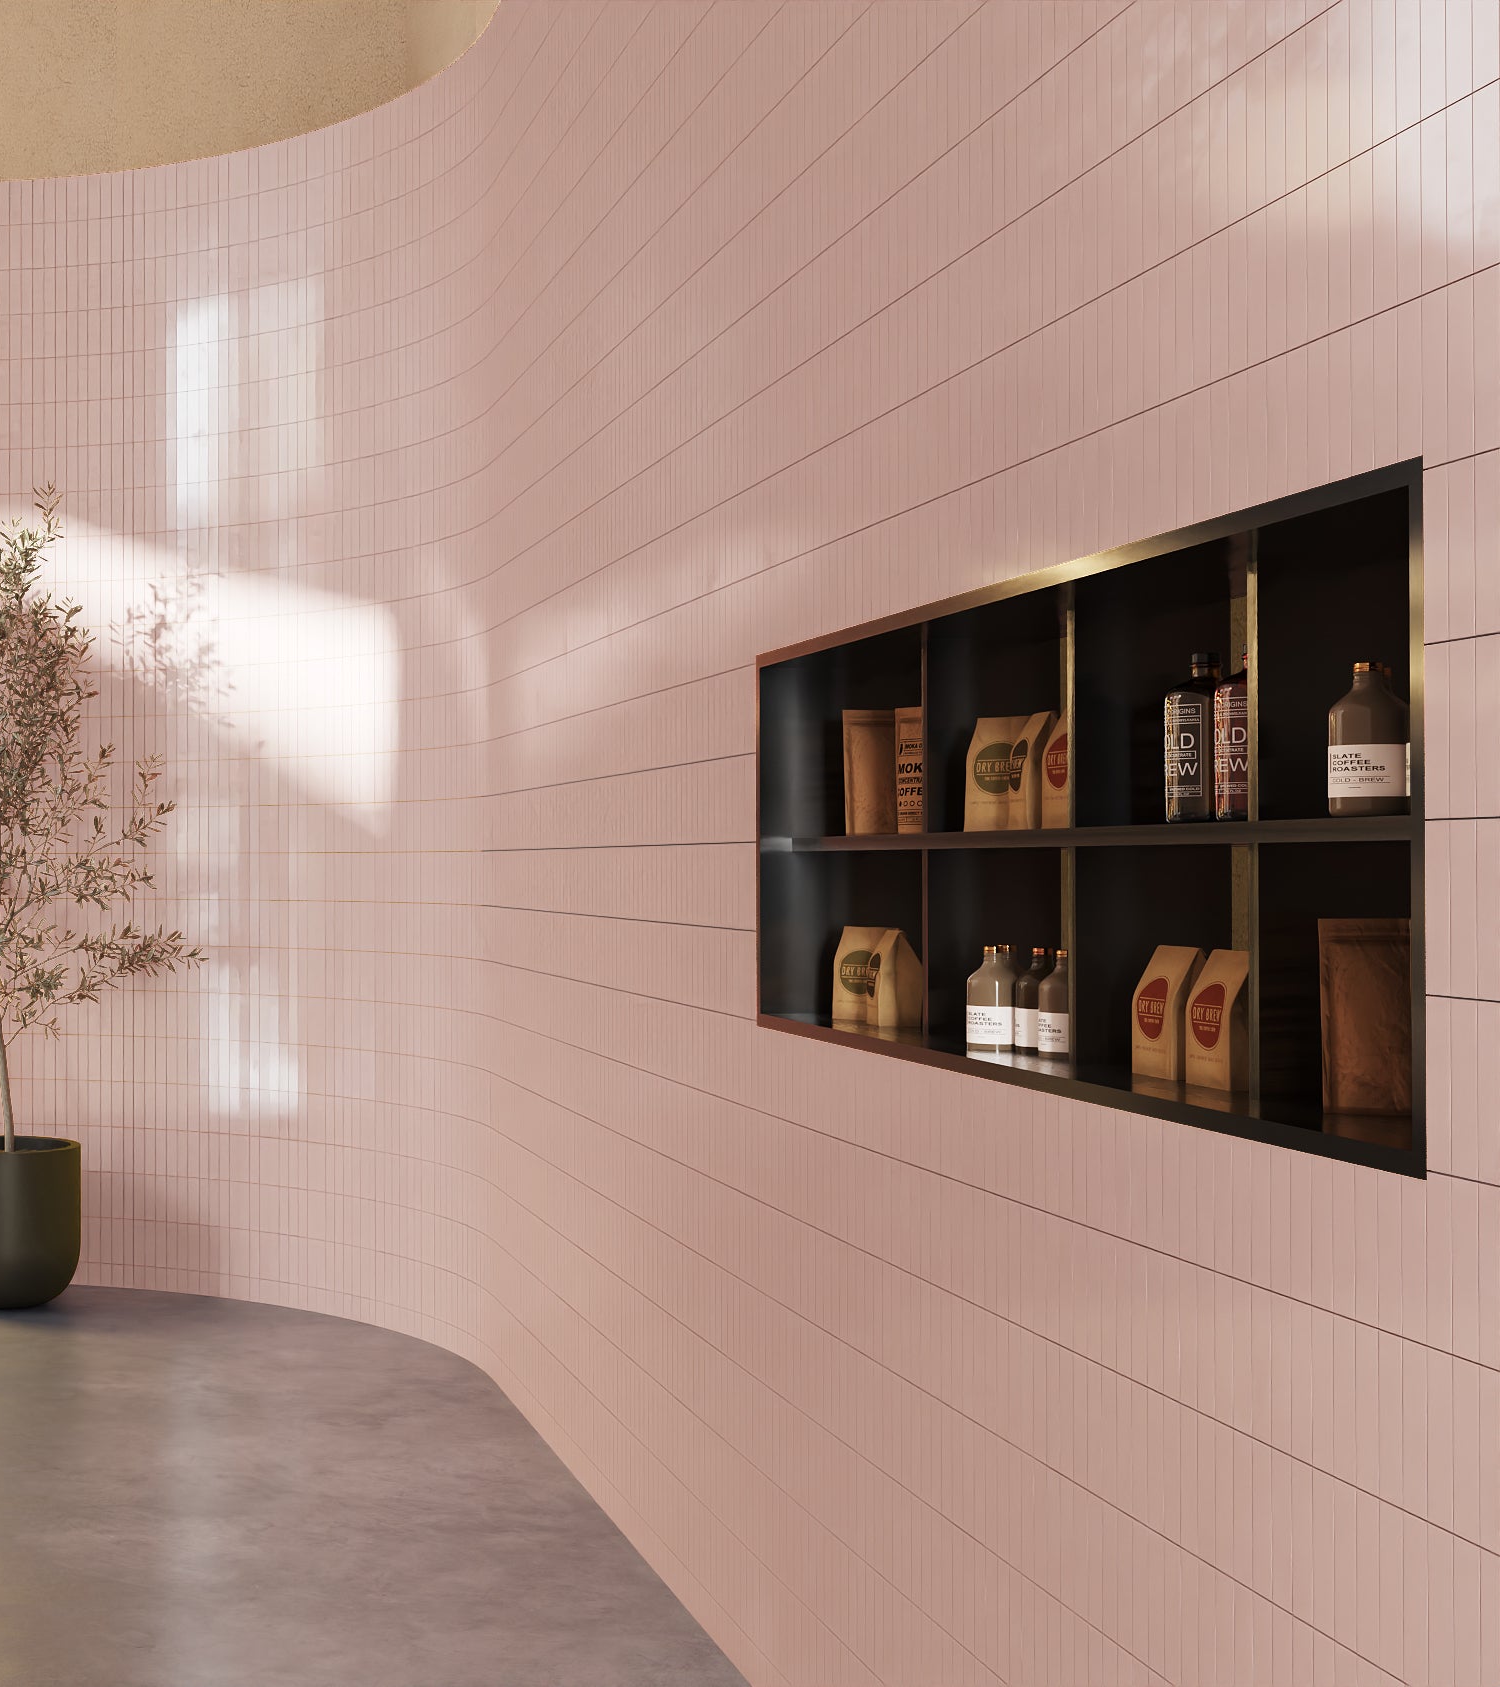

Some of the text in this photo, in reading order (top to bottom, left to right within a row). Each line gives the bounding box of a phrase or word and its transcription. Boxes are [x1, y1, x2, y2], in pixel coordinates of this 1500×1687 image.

[1164, 733, 1195, 750] OLD
[1214, 727, 1247, 745] OLD
[1057, 753, 1067, 766] BRE
[1214, 758, 1248, 772] REW
[898, 763, 923, 775] MOK
[976, 761, 991, 773] DRY
[1165, 762, 1198, 777] REW
[898, 786, 923, 797] OFFE
[1138, 1000, 1150, 1013] DRY
[1192, 1006, 1222, 1022] DRY BREW
